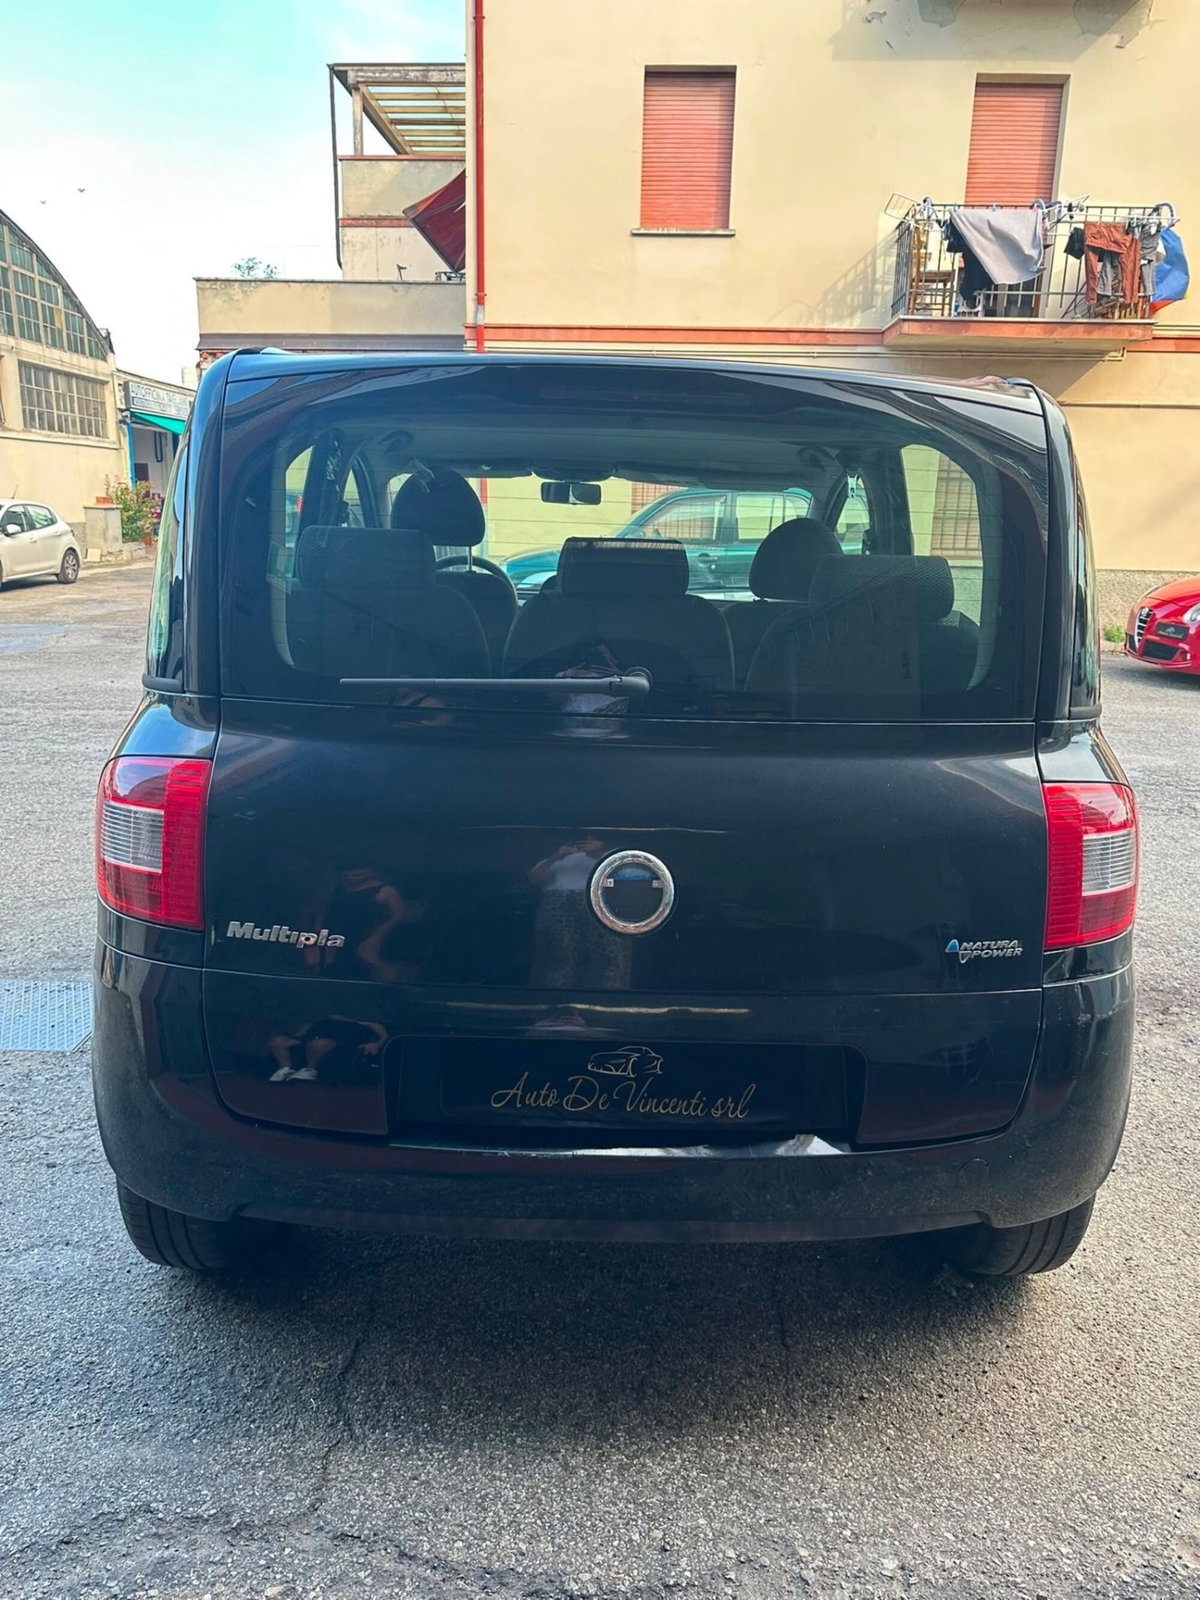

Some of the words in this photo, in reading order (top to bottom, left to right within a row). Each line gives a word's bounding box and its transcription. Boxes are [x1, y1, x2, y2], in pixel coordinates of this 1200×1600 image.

[226, 921, 346, 949] Multipla
[970, 947, 1023, 958] POWER
[490, 1071, 559, 1108] Auto
[563, 1075, 610, 1112] De
[613, 1076, 708, 1116] Vincenti
[711, 1083, 756, 1118] srl
